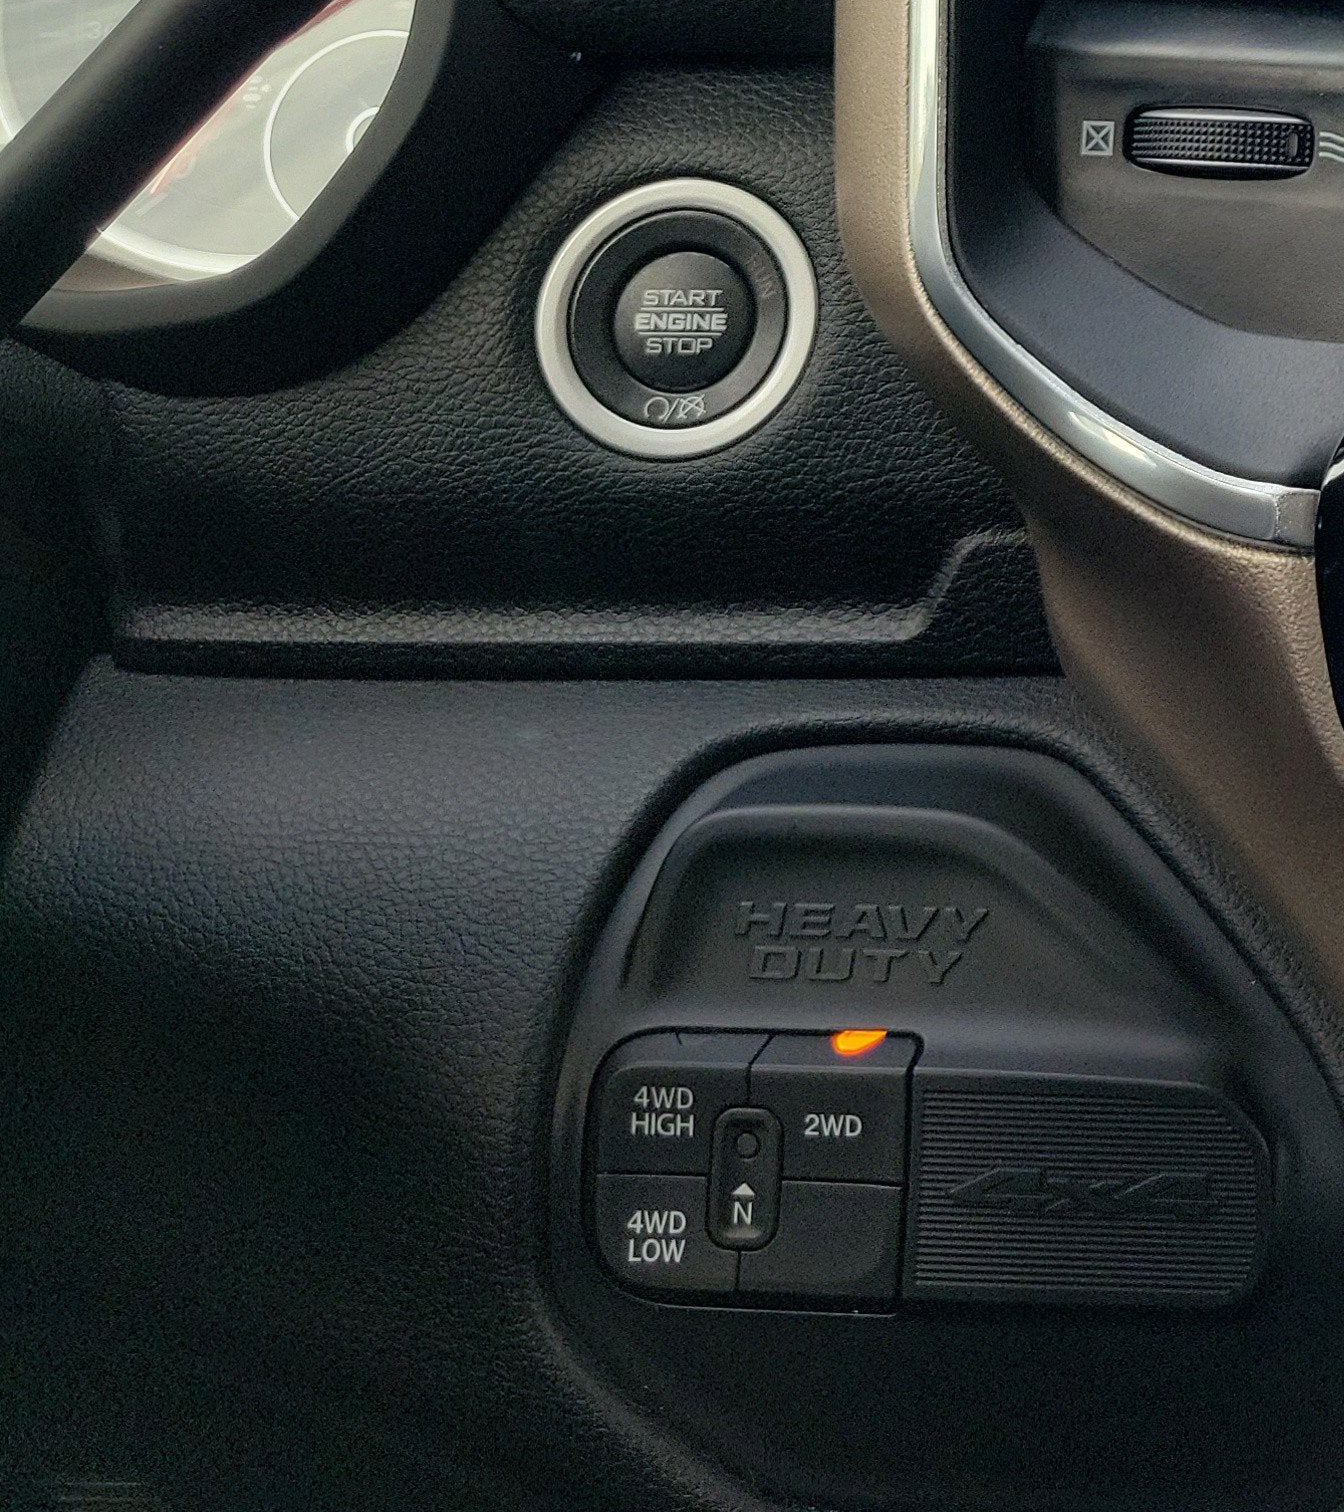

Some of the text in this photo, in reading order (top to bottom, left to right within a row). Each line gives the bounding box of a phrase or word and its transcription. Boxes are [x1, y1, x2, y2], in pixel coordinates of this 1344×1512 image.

[643, 289, 723, 306] START
[634, 313, 728, 331] ENGINE
[645, 338, 713, 355] STOP
[735, 900, 989, 942] HEAVY
[748, 945, 965, 985] DUTY
[633, 1086, 693, 1111] 4WD
[630, 1112, 695, 1137] HIGH
[804, 1114, 863, 1137] 2WD
[627, 1210, 686, 1236] 4WD
[733, 1202, 753, 1226] N
[627, 1237, 686, 1263] LOW
